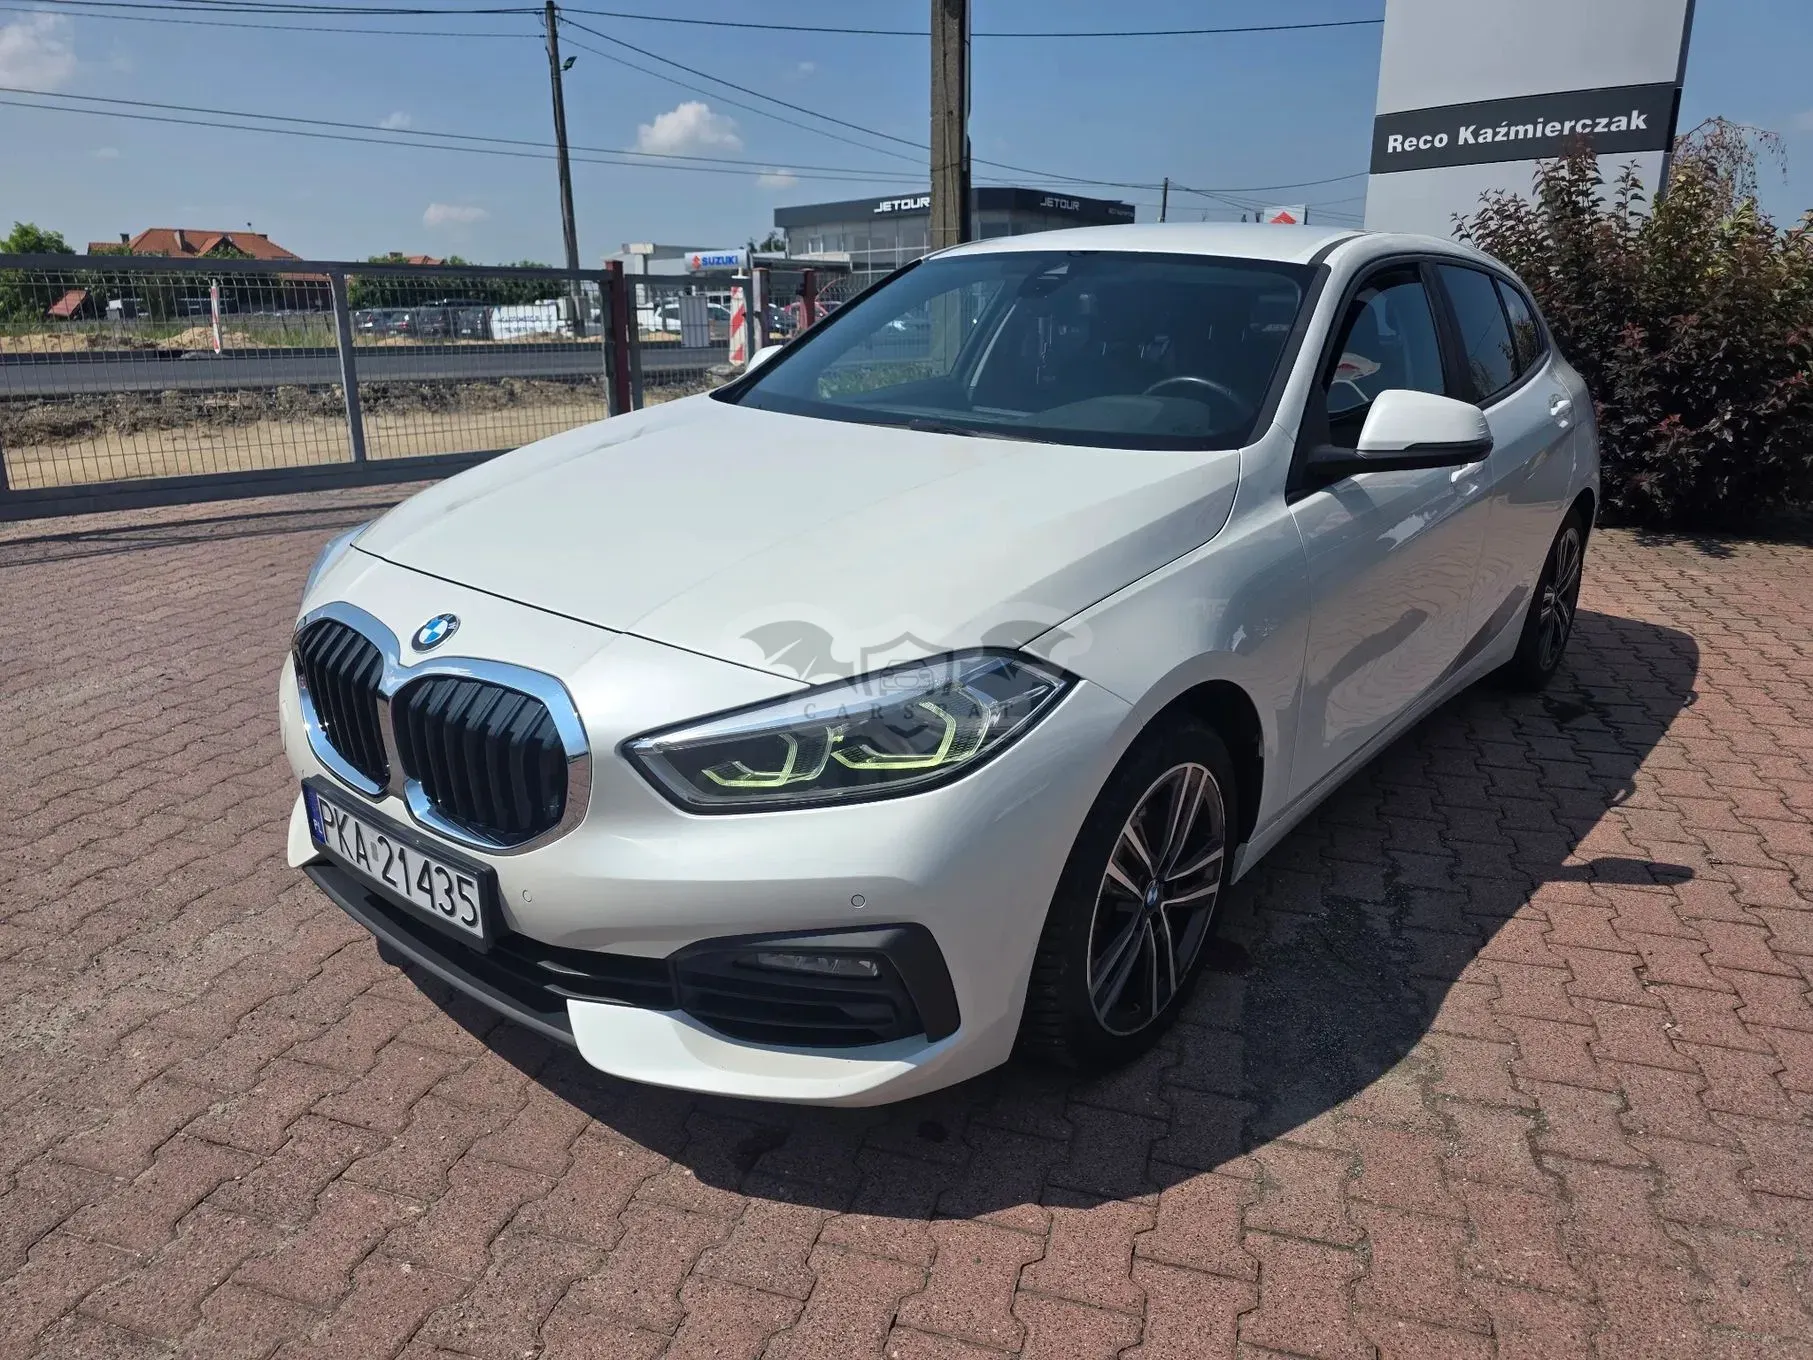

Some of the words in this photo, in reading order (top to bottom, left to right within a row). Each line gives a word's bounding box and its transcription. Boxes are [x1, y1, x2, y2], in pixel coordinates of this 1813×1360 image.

[1387, 134, 1449, 153] Reco
[1458, 109, 1648, 145] Kaźmierczak
[873, 196, 931, 213] JETOUR
[1040, 197, 1080, 211] JETOUR
[702, 255, 739, 266] SUZUKI
[318, 799, 372, 873] PKA
[377, 835, 479, 928] 21435
